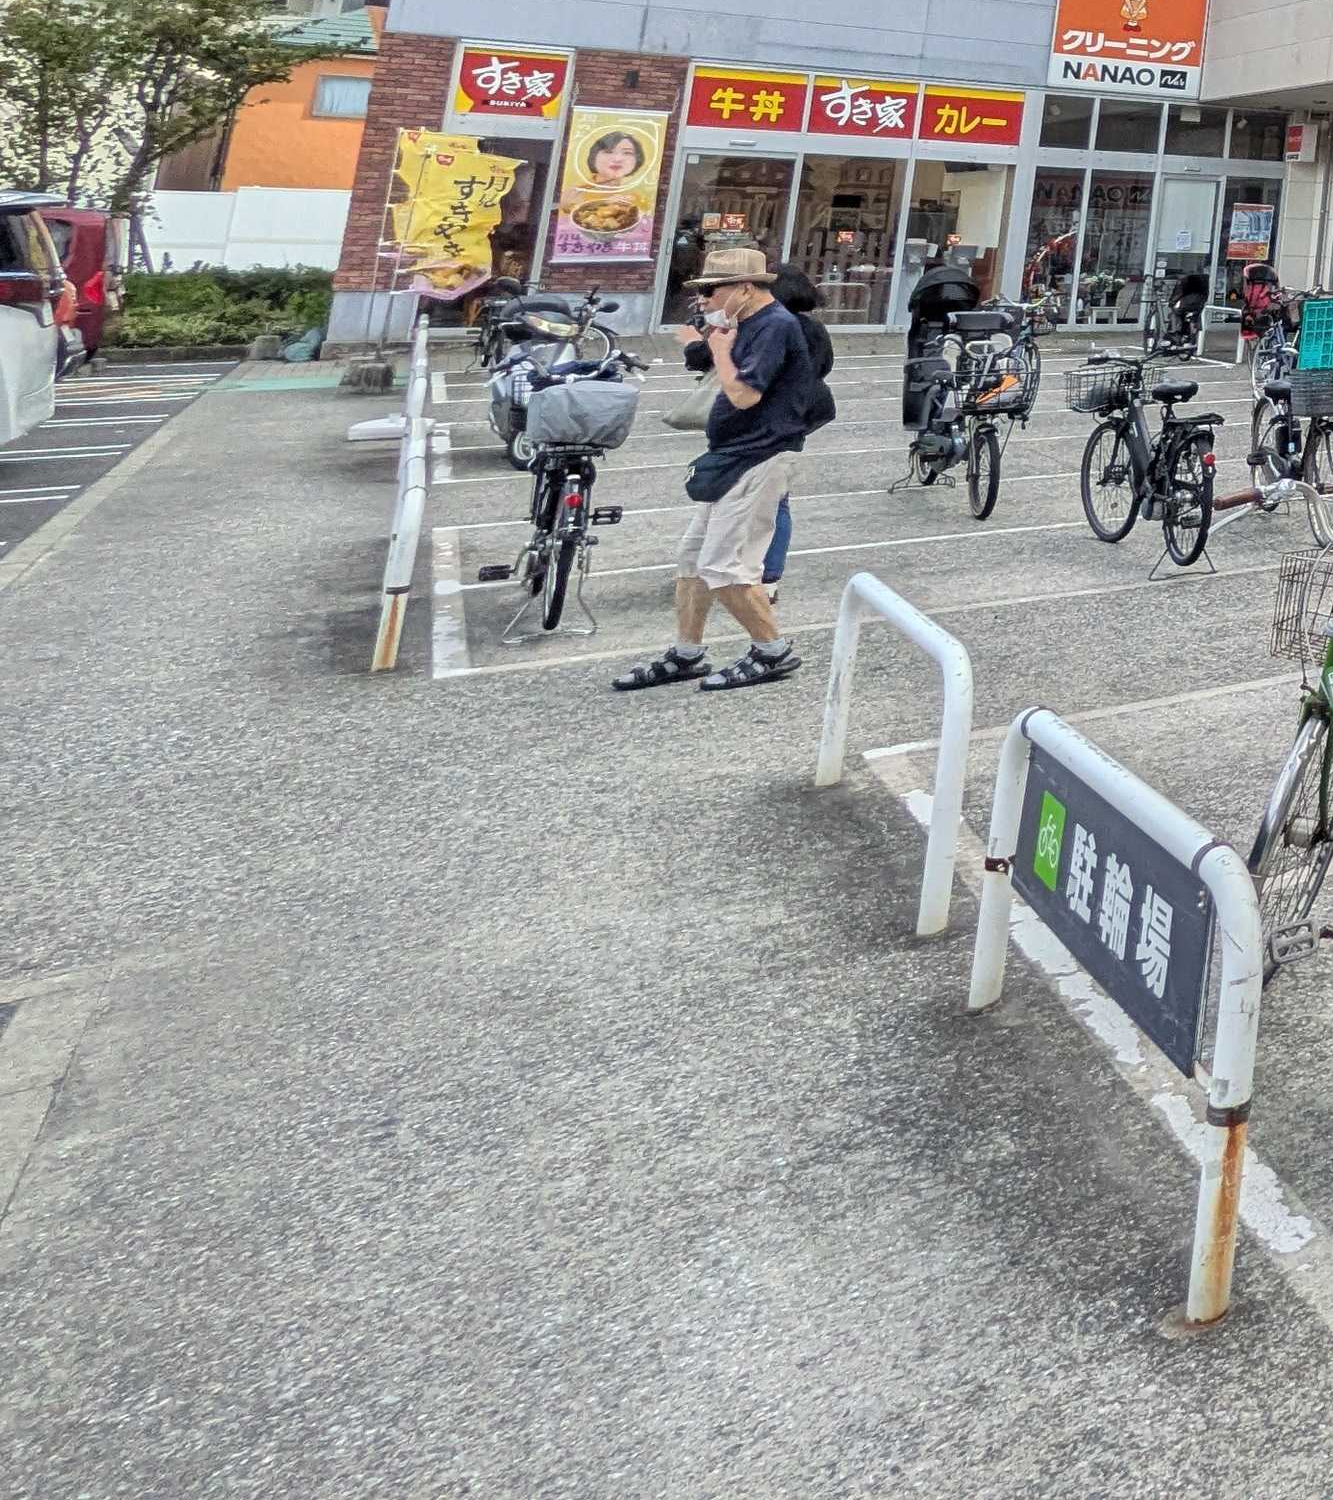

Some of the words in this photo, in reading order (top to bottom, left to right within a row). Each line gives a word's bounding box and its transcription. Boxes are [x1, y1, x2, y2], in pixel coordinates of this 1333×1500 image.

[1062, 29, 1196, 62] クリーニング
[472, 56, 556, 101] すき家
[1062, 61, 1155, 86] NANAO
[489, 100, 527, 109] SUKIYA
[710, 86, 786, 122] 牛丼
[820, 78, 910, 134] すき家
[934, 103, 1008, 135] カレー
[433, 175, 487, 258] すきやき
[1066, 822, 1173, 999] 駐輪場
